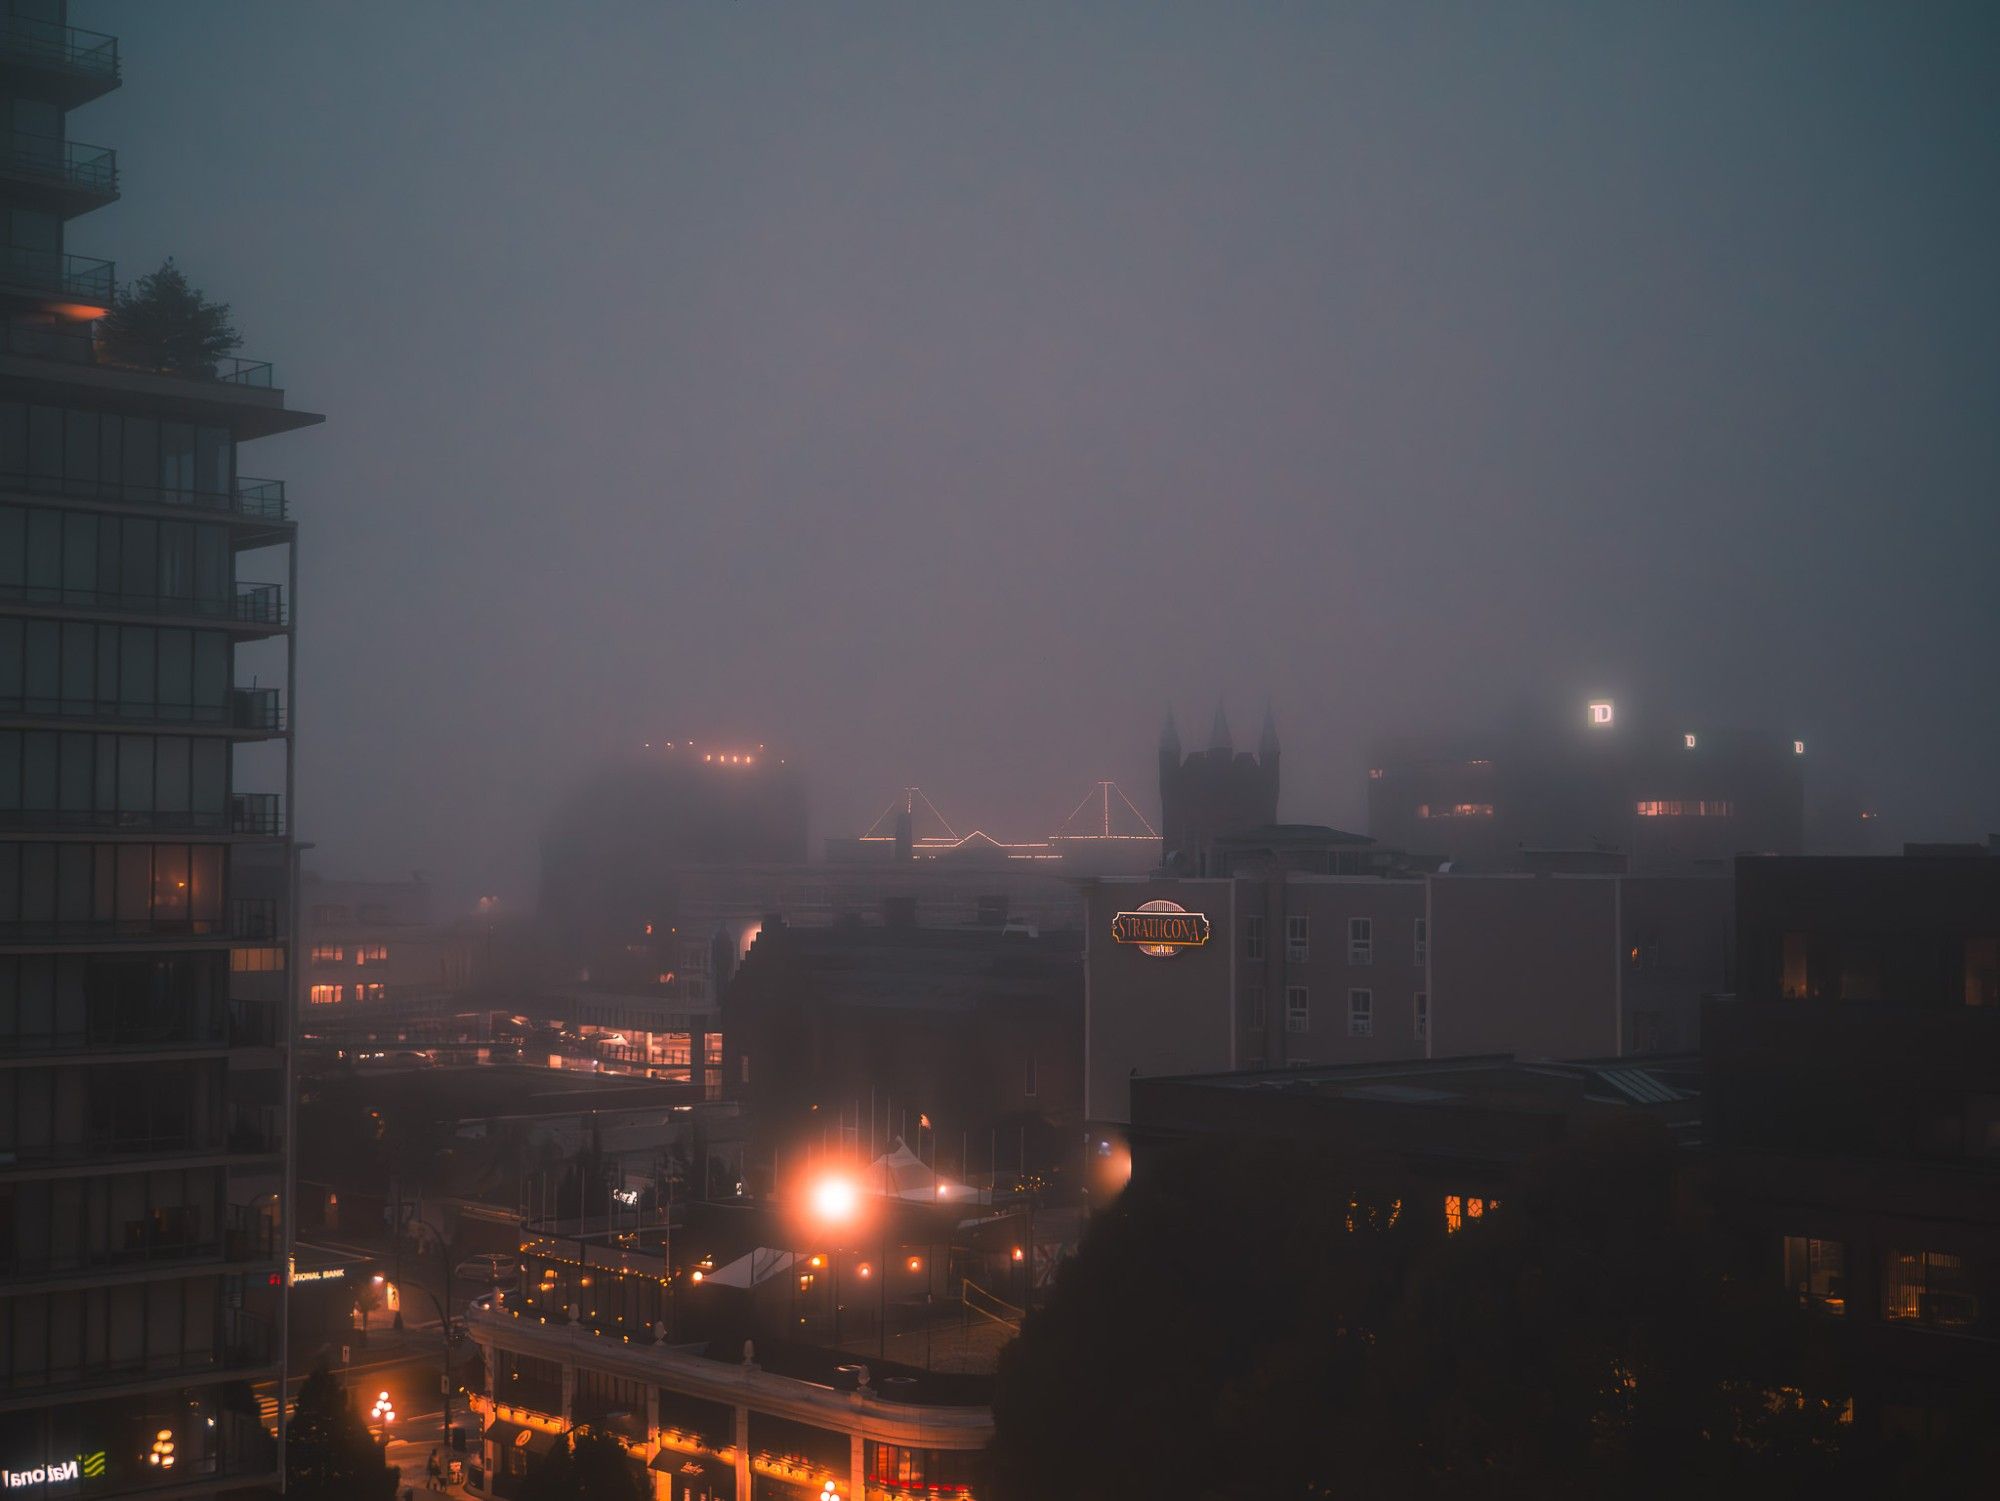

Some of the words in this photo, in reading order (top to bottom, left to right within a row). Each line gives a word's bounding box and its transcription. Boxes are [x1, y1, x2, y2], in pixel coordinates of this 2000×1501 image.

[1590, 704, 1612, 723] TD
[1685, 735, 1695, 747] TD
[1794, 741, 1804, 753] TD
[1119, 916, 1199, 941] STRATHCONA
[323, 1269, 344, 1279] BANK
